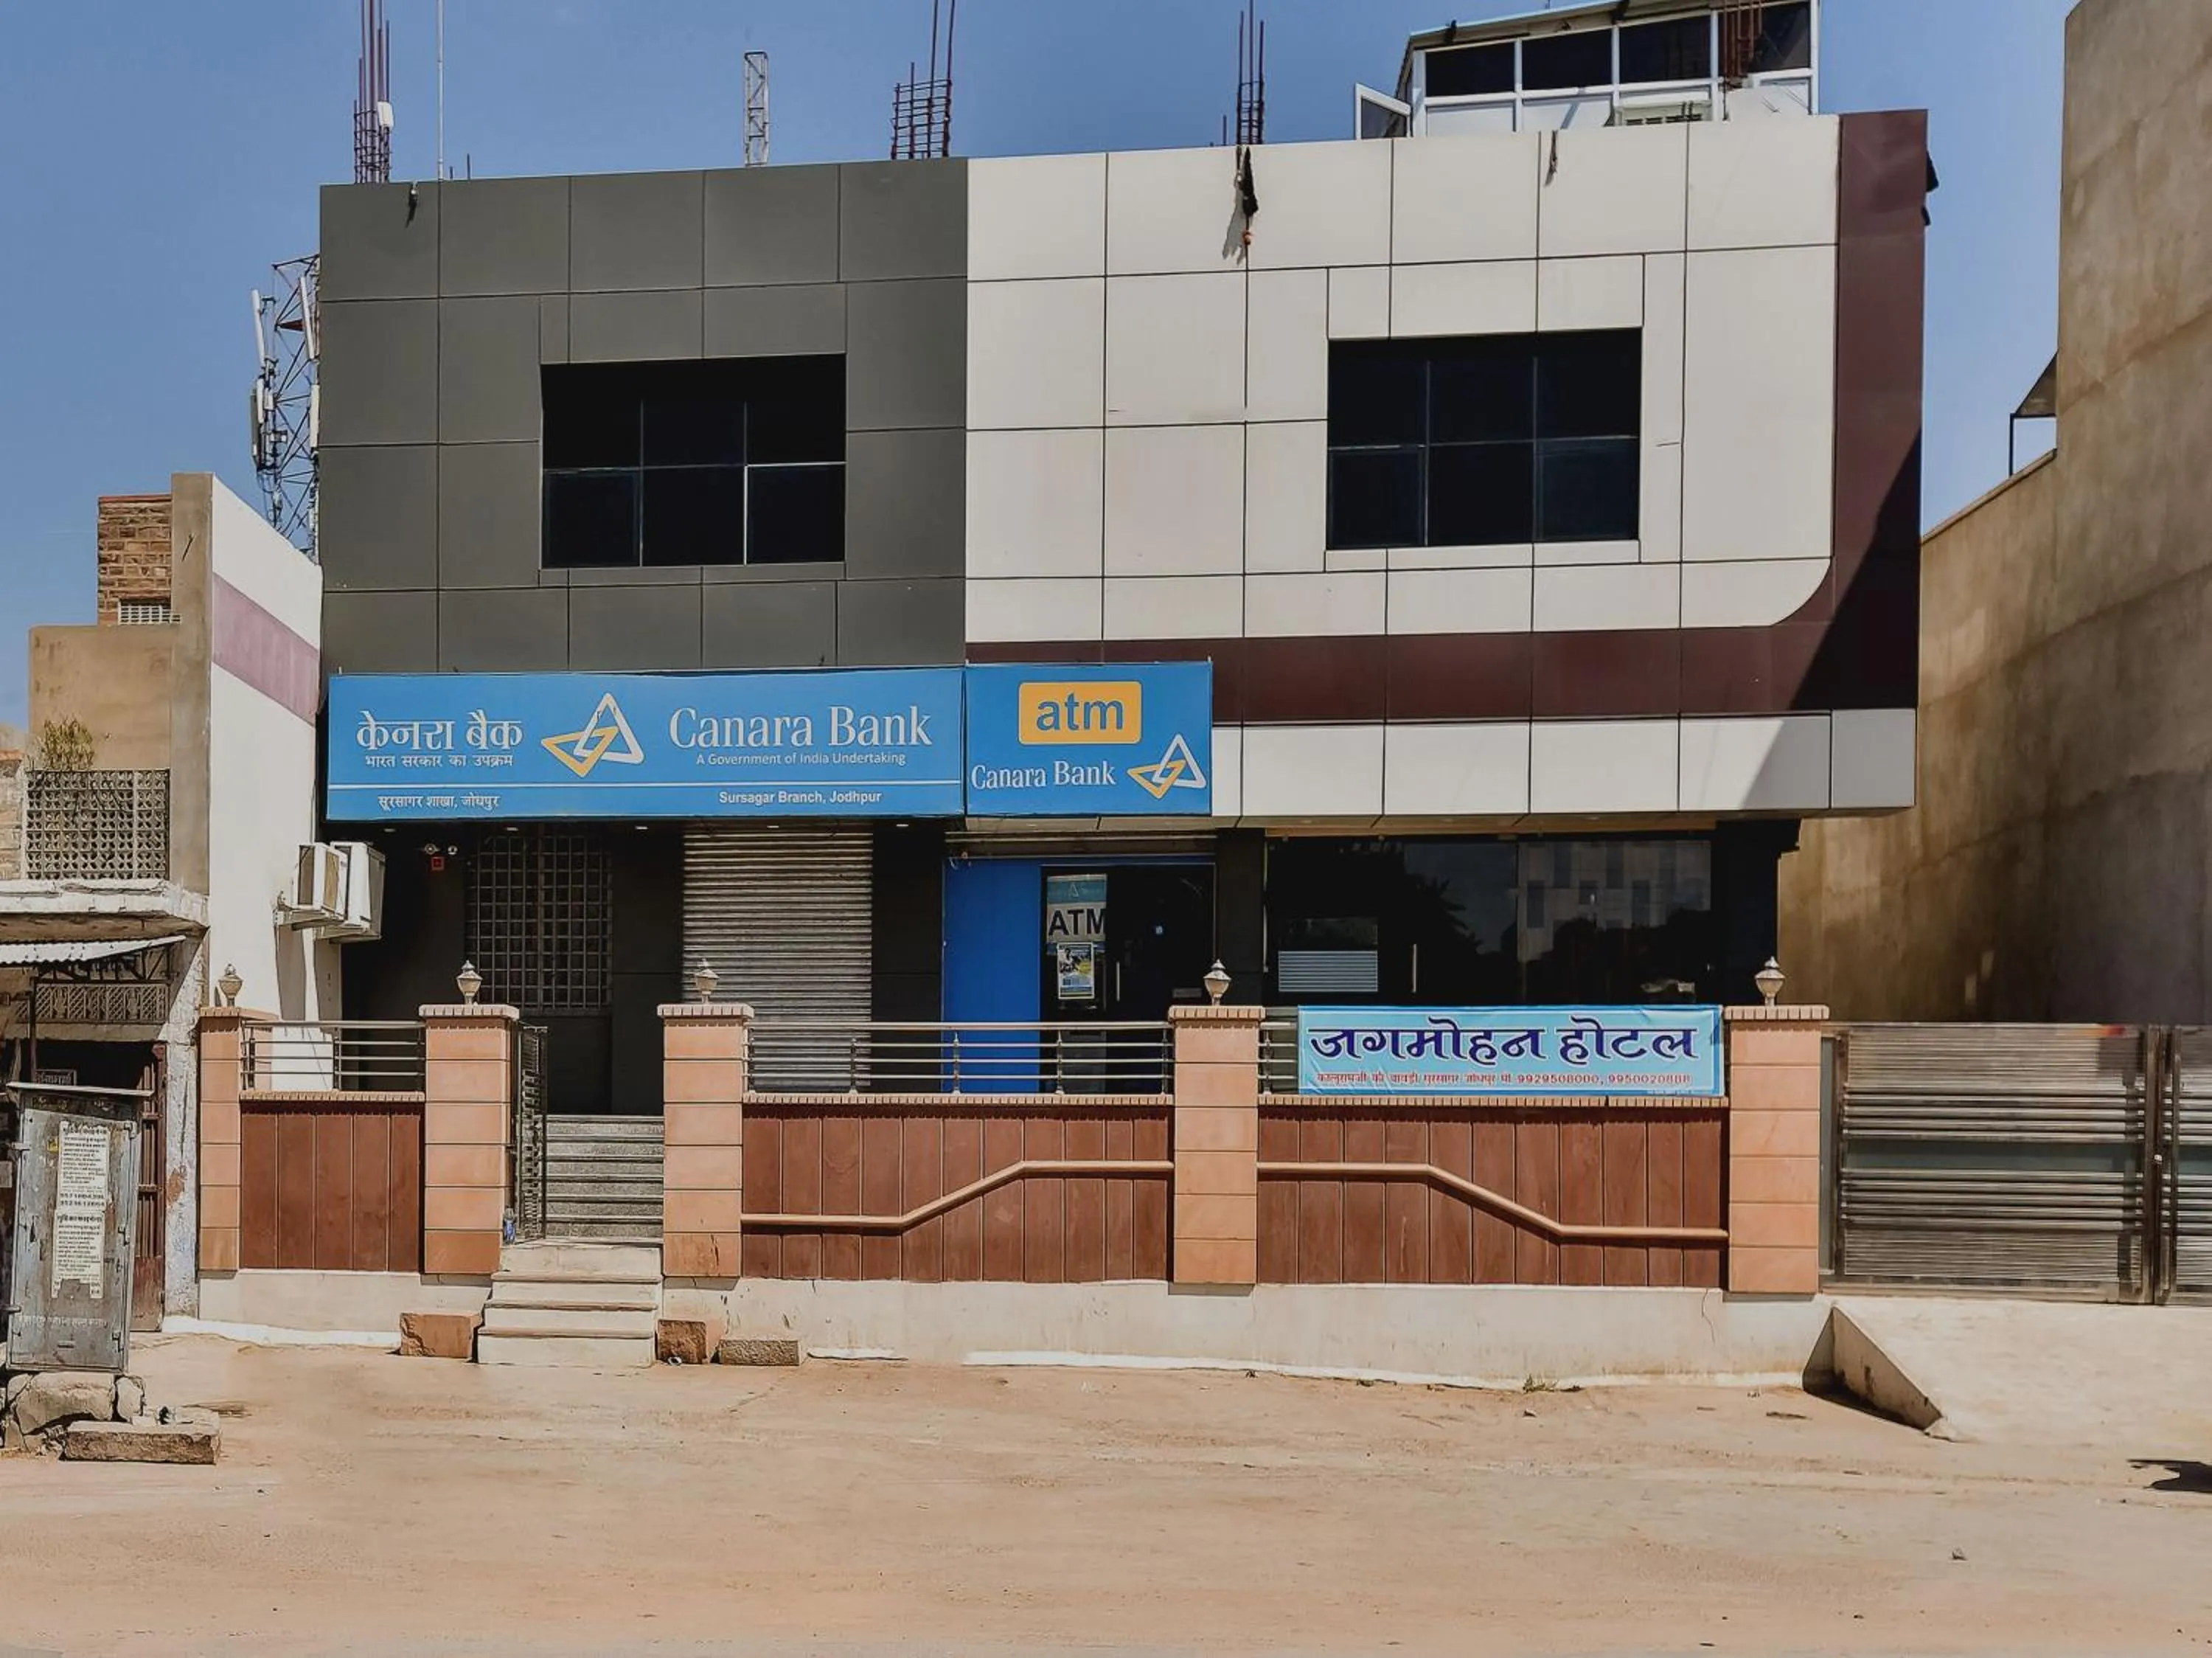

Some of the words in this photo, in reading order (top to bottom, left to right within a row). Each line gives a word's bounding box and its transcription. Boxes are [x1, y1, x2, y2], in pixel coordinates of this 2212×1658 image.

[1036, 691, 1124, 731] atm
[357, 710, 456, 750] केनरा
[669, 707, 813, 749] Canara
[827, 704, 933, 746] Bank
[365, 755, 395, 766] भारत
[401, 755, 442, 766] सरकार
[448, 755, 466, 766] का
[473, 755, 514, 766] उपक्रम
[696, 755, 704, 765] A
[708, 753, 781, 765] Government
[785, 752, 797, 764] of
[800, 752, 830, 764] India
[832, 752, 906, 766] Undertaking
[971, 765, 1046, 789] Canara
[1054, 760, 1116, 786] Bank
[460, 792, 501, 811] जोधपुर
[719, 791, 775, 806] Sursagar
[778, 791, 826, 805] Branch,
[830, 791, 882, 805] Jodhpur
[1048, 909, 1106, 936] ATM
[1308, 1016, 1546, 1066] जगमोहन
[1555, 1015, 1698, 1065] होटल
